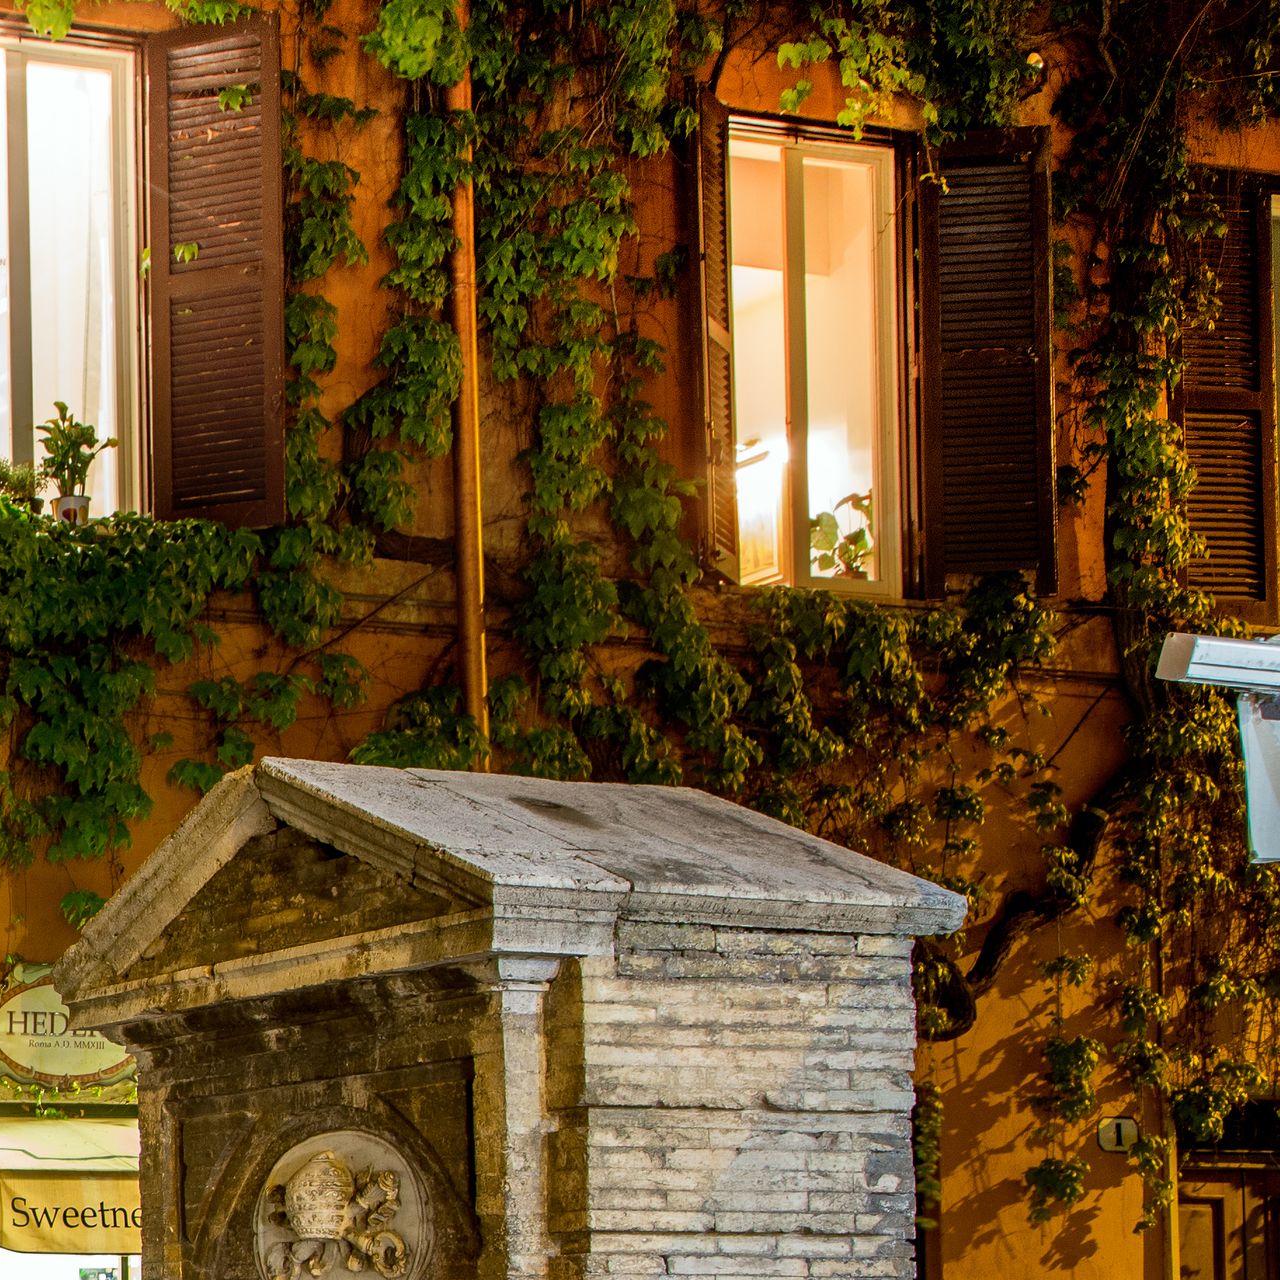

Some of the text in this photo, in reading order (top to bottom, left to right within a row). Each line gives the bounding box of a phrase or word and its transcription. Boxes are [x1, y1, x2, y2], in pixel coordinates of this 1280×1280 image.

[28, 1039, 52, 1049] Roma
[73, 1040, 105, 1050] MMXIII
[10, 1196, 142, 1229] Sweetne
